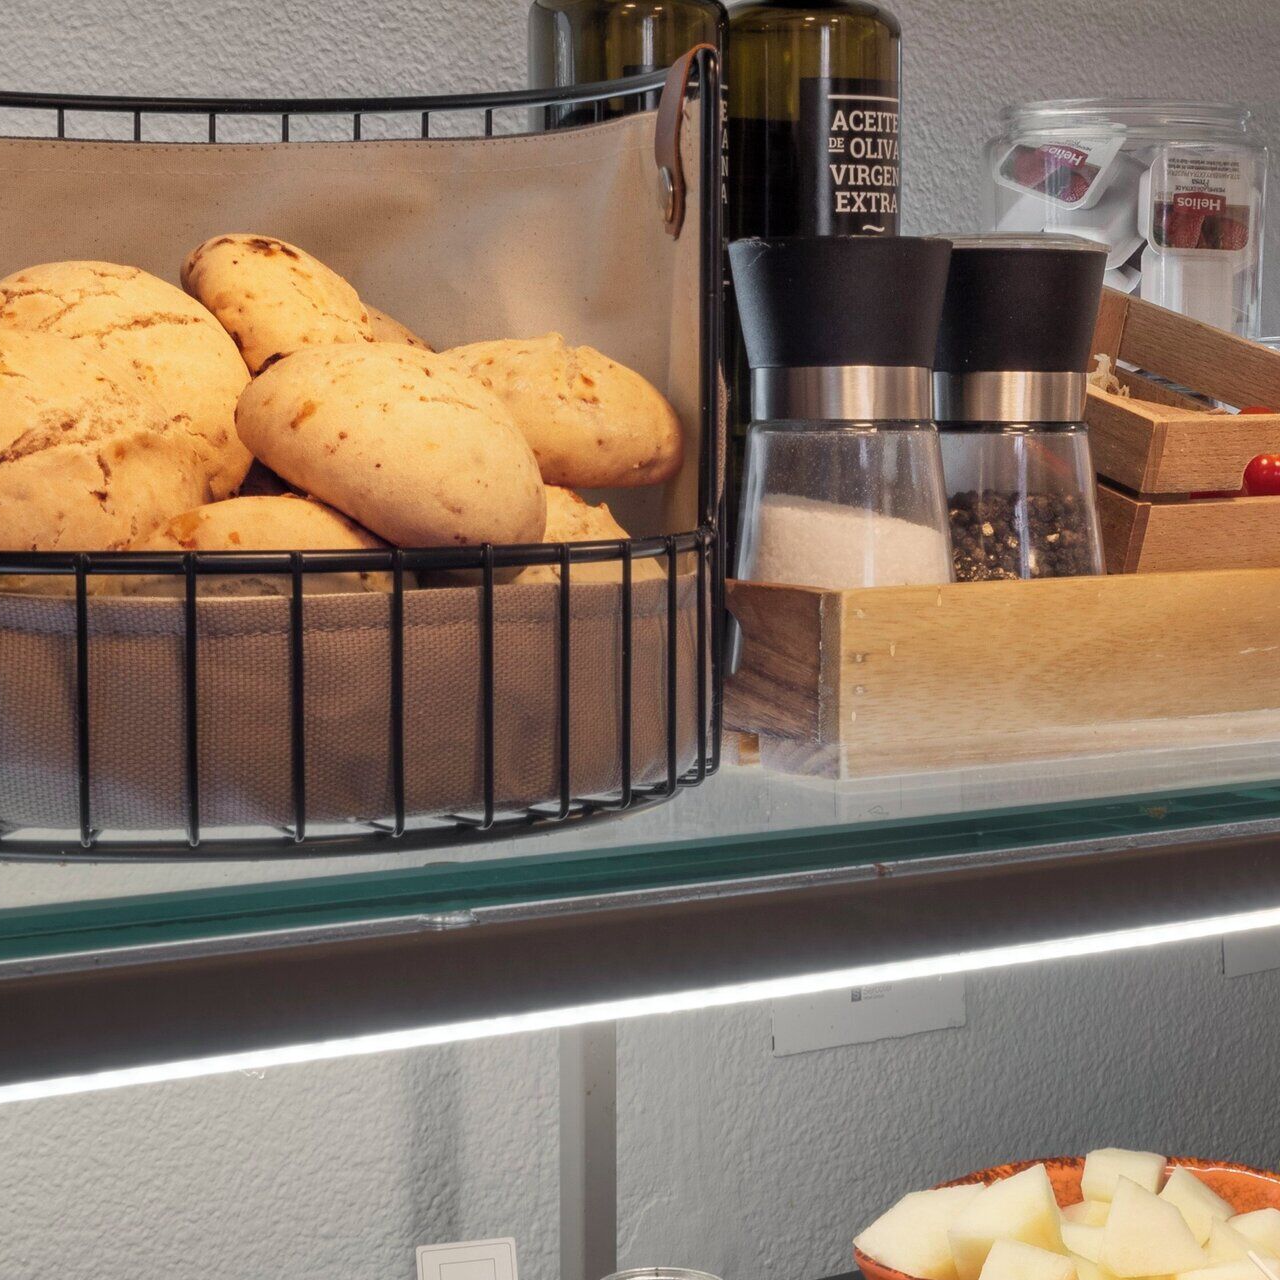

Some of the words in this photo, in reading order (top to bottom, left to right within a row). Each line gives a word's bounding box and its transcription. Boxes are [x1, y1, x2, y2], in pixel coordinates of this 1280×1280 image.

[831, 110, 899, 134] ACEITE
[828, 137, 844, 149] DE
[850, 137, 899, 161] OLIVA
[1044, 146, 1084, 167] Helio
[829, 164, 899, 187] VIRGEN
[835, 191, 898, 214] EXTRA
[1176, 196, 1221, 212] Helios
